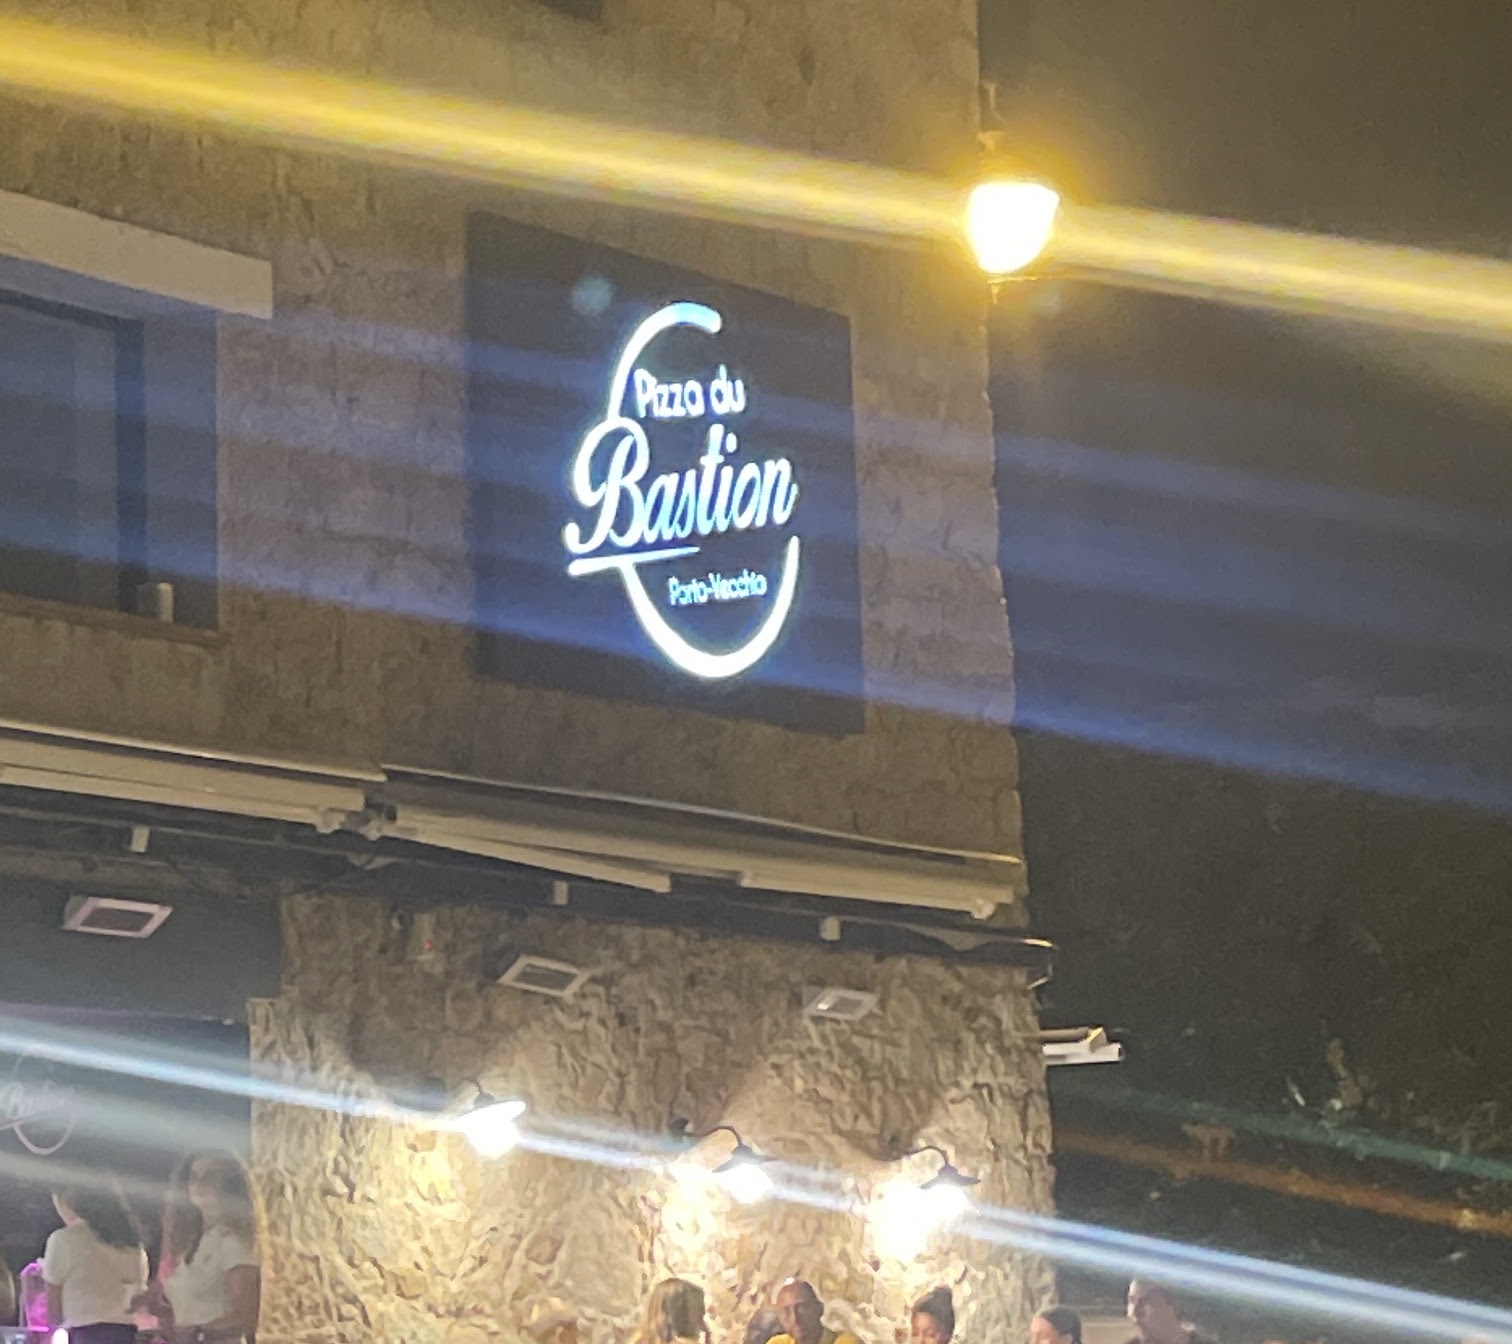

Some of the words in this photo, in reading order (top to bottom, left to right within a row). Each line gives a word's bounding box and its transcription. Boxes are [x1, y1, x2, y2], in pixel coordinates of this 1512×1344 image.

[634, 368, 706, 418] Pizza
[710, 364, 746, 415] du
[564, 417, 798, 553] Bastion
[668, 568, 768, 605] Porto-Vecchio
